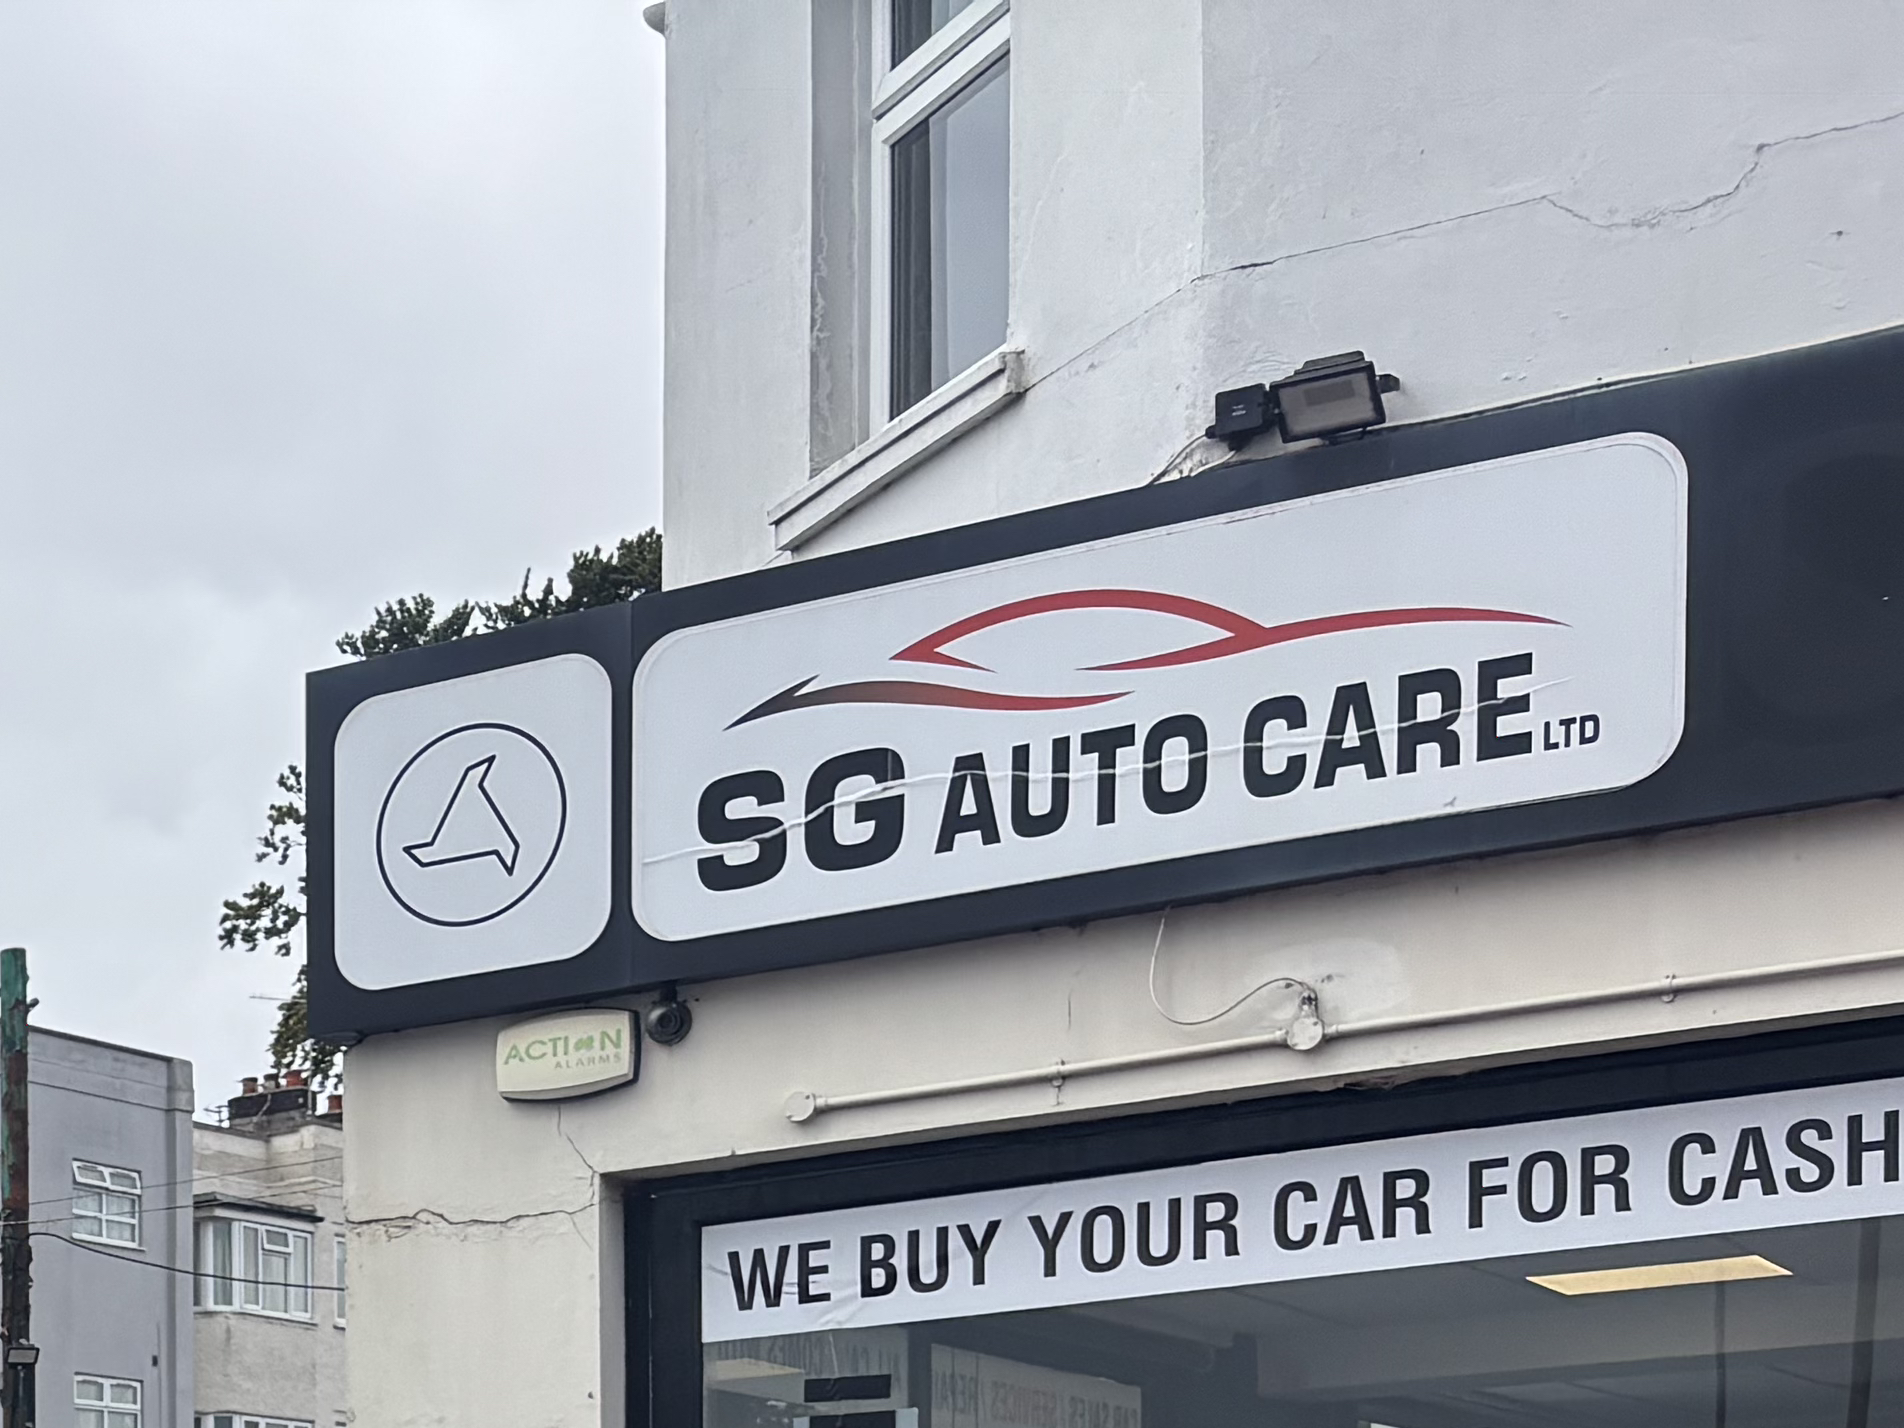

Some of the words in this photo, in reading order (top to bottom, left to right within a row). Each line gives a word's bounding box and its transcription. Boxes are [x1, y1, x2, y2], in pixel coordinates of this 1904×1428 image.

[696, 747, 906, 892] SG
[934, 714, 1209, 854] AUTO
[1243, 651, 1535, 800] CARE
[1543, 713, 1602, 754] LTD
[555, 1053, 621, 1069] ALARMS
[728, 1240, 832, 1311] WE
[859, 1218, 1002, 1299] BUY
[1027, 1191, 1240, 1278] YOUR
[1273, 1167, 1432, 1250] CAR
[1468, 1143, 1633, 1230] FOR
[1668, 1108, 1903, 1206] CASH
